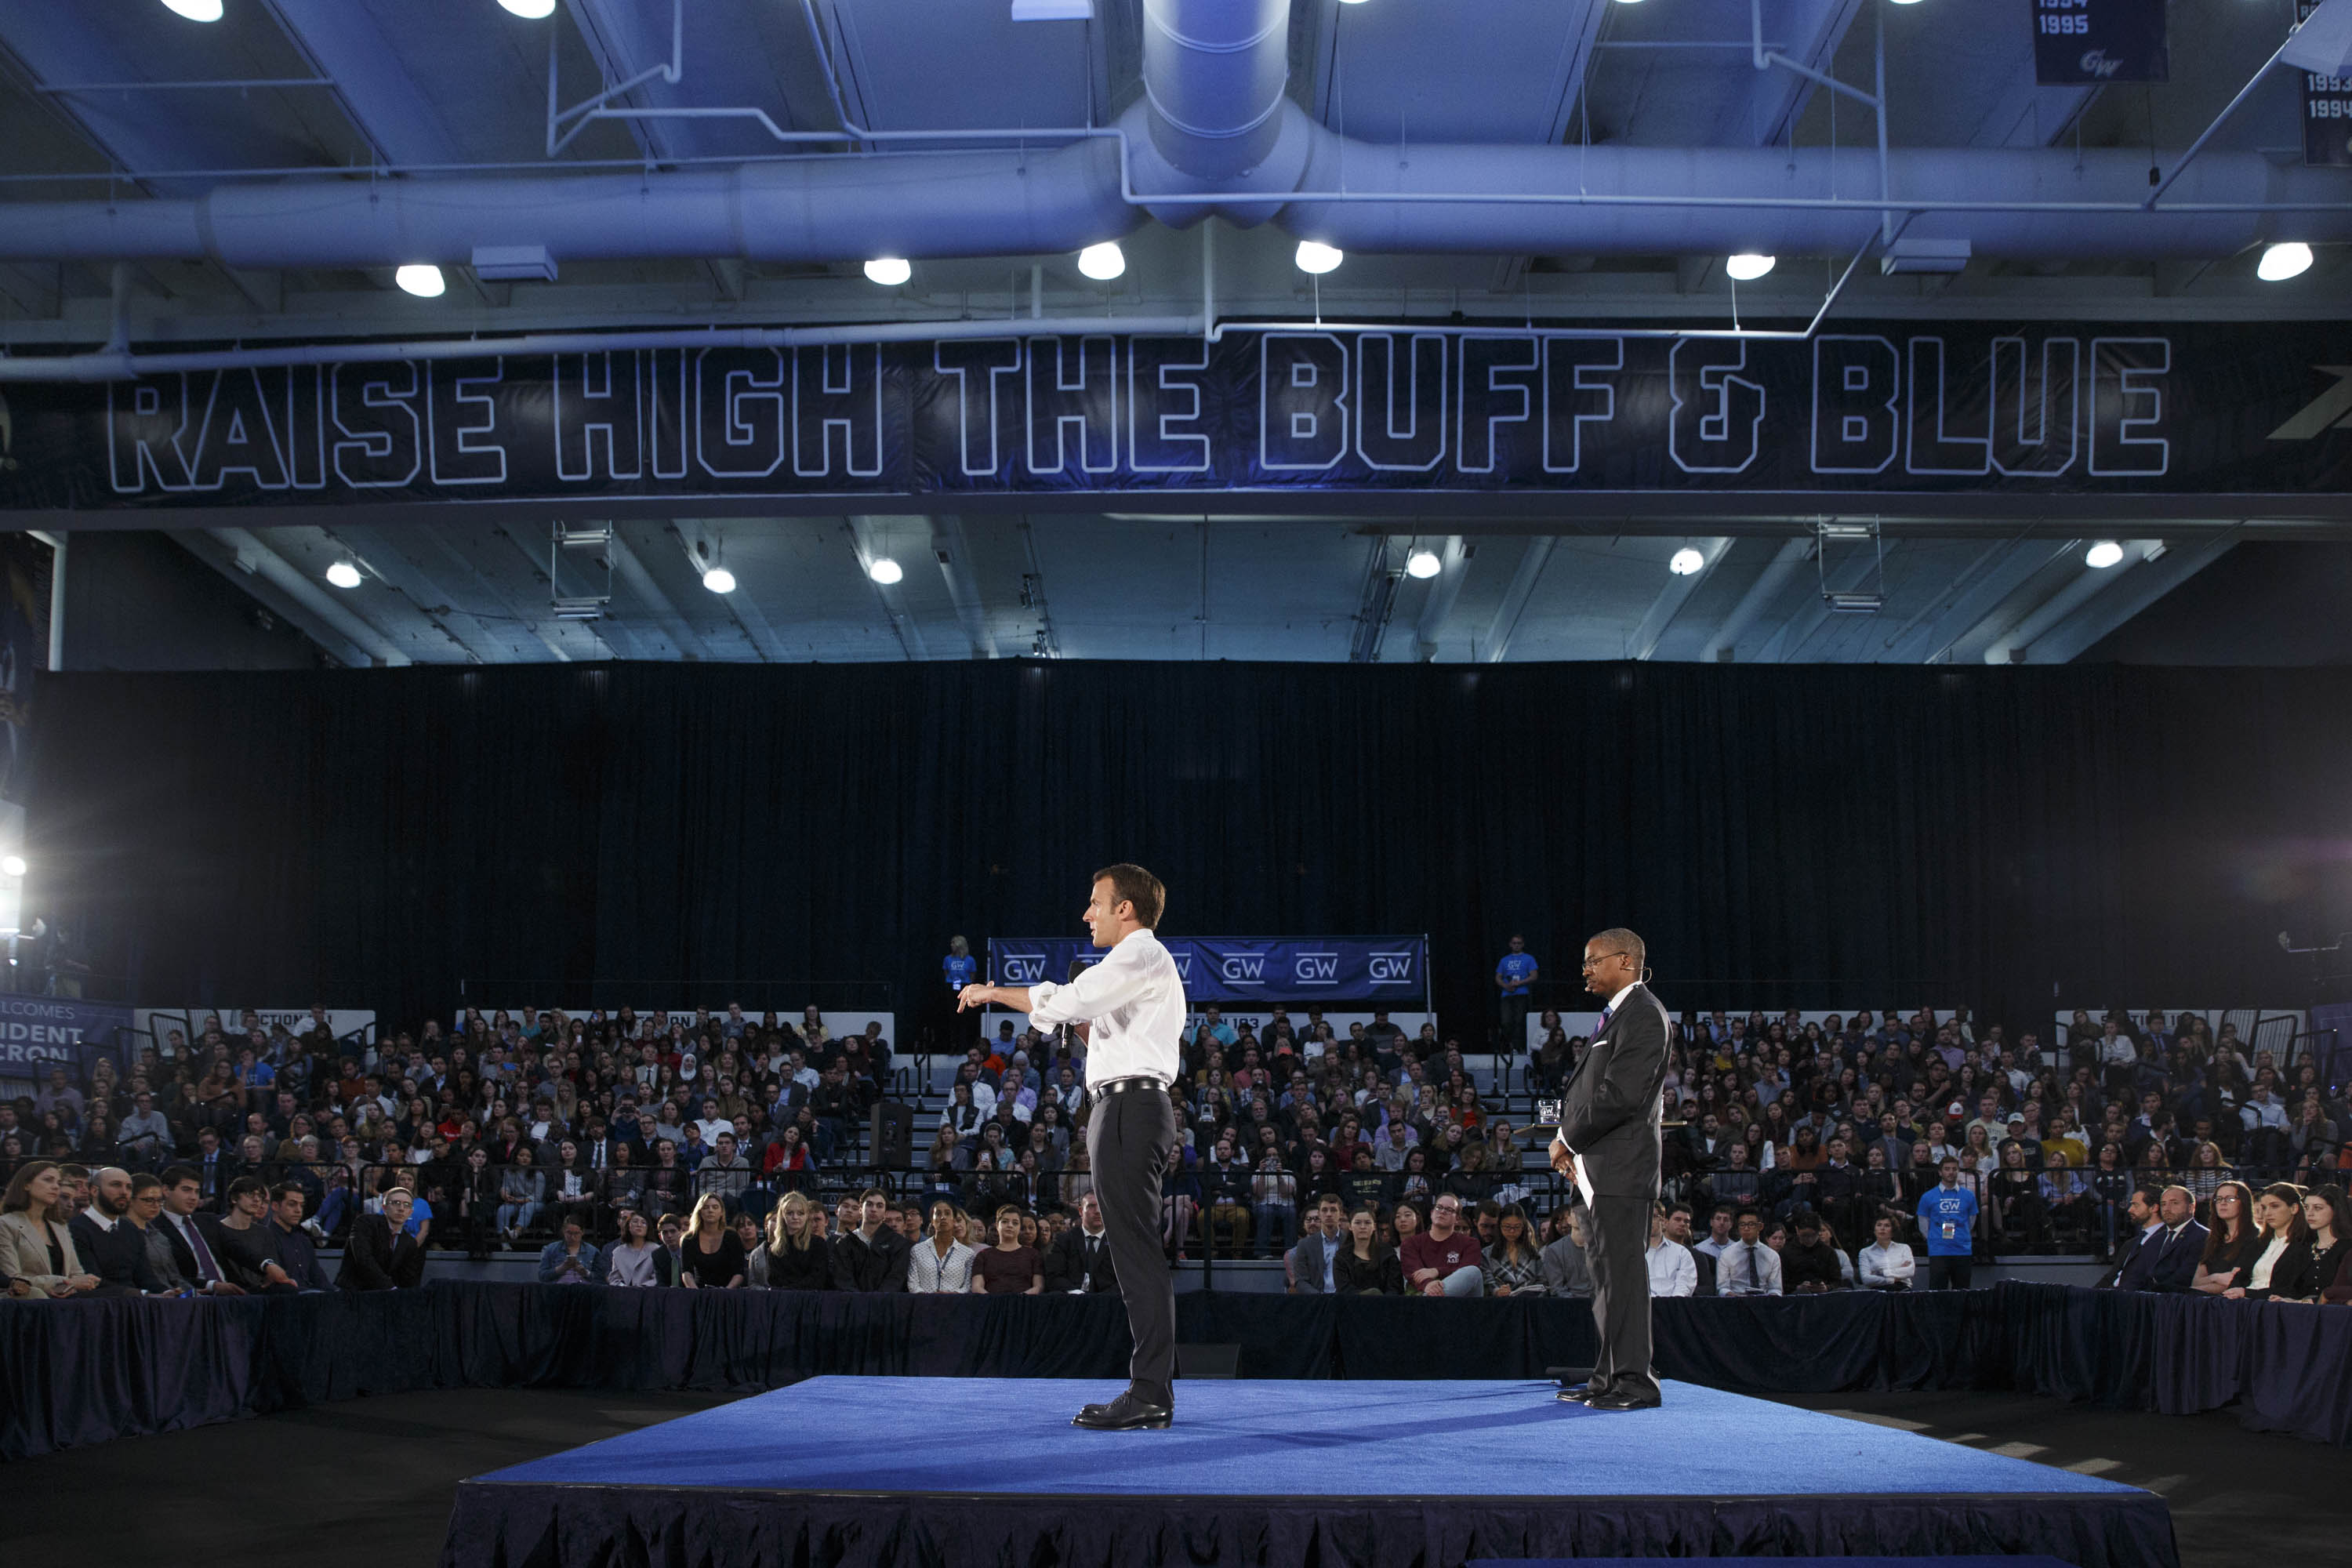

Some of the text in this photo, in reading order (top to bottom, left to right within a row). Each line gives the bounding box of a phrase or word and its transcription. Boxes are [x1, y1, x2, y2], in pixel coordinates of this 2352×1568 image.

[2039, 14, 2089, 35] 1995
[107, 332, 2172, 493] RAISE HIGH THE BUFF & BLUE
[1004, 960, 1046, 981] GW
[1222, 958, 1265, 980] GW
[1295, 958, 1338, 979] GW
[1369, 957, 1410, 978] GW
[1939, 1201, 1960, 1210] GW
